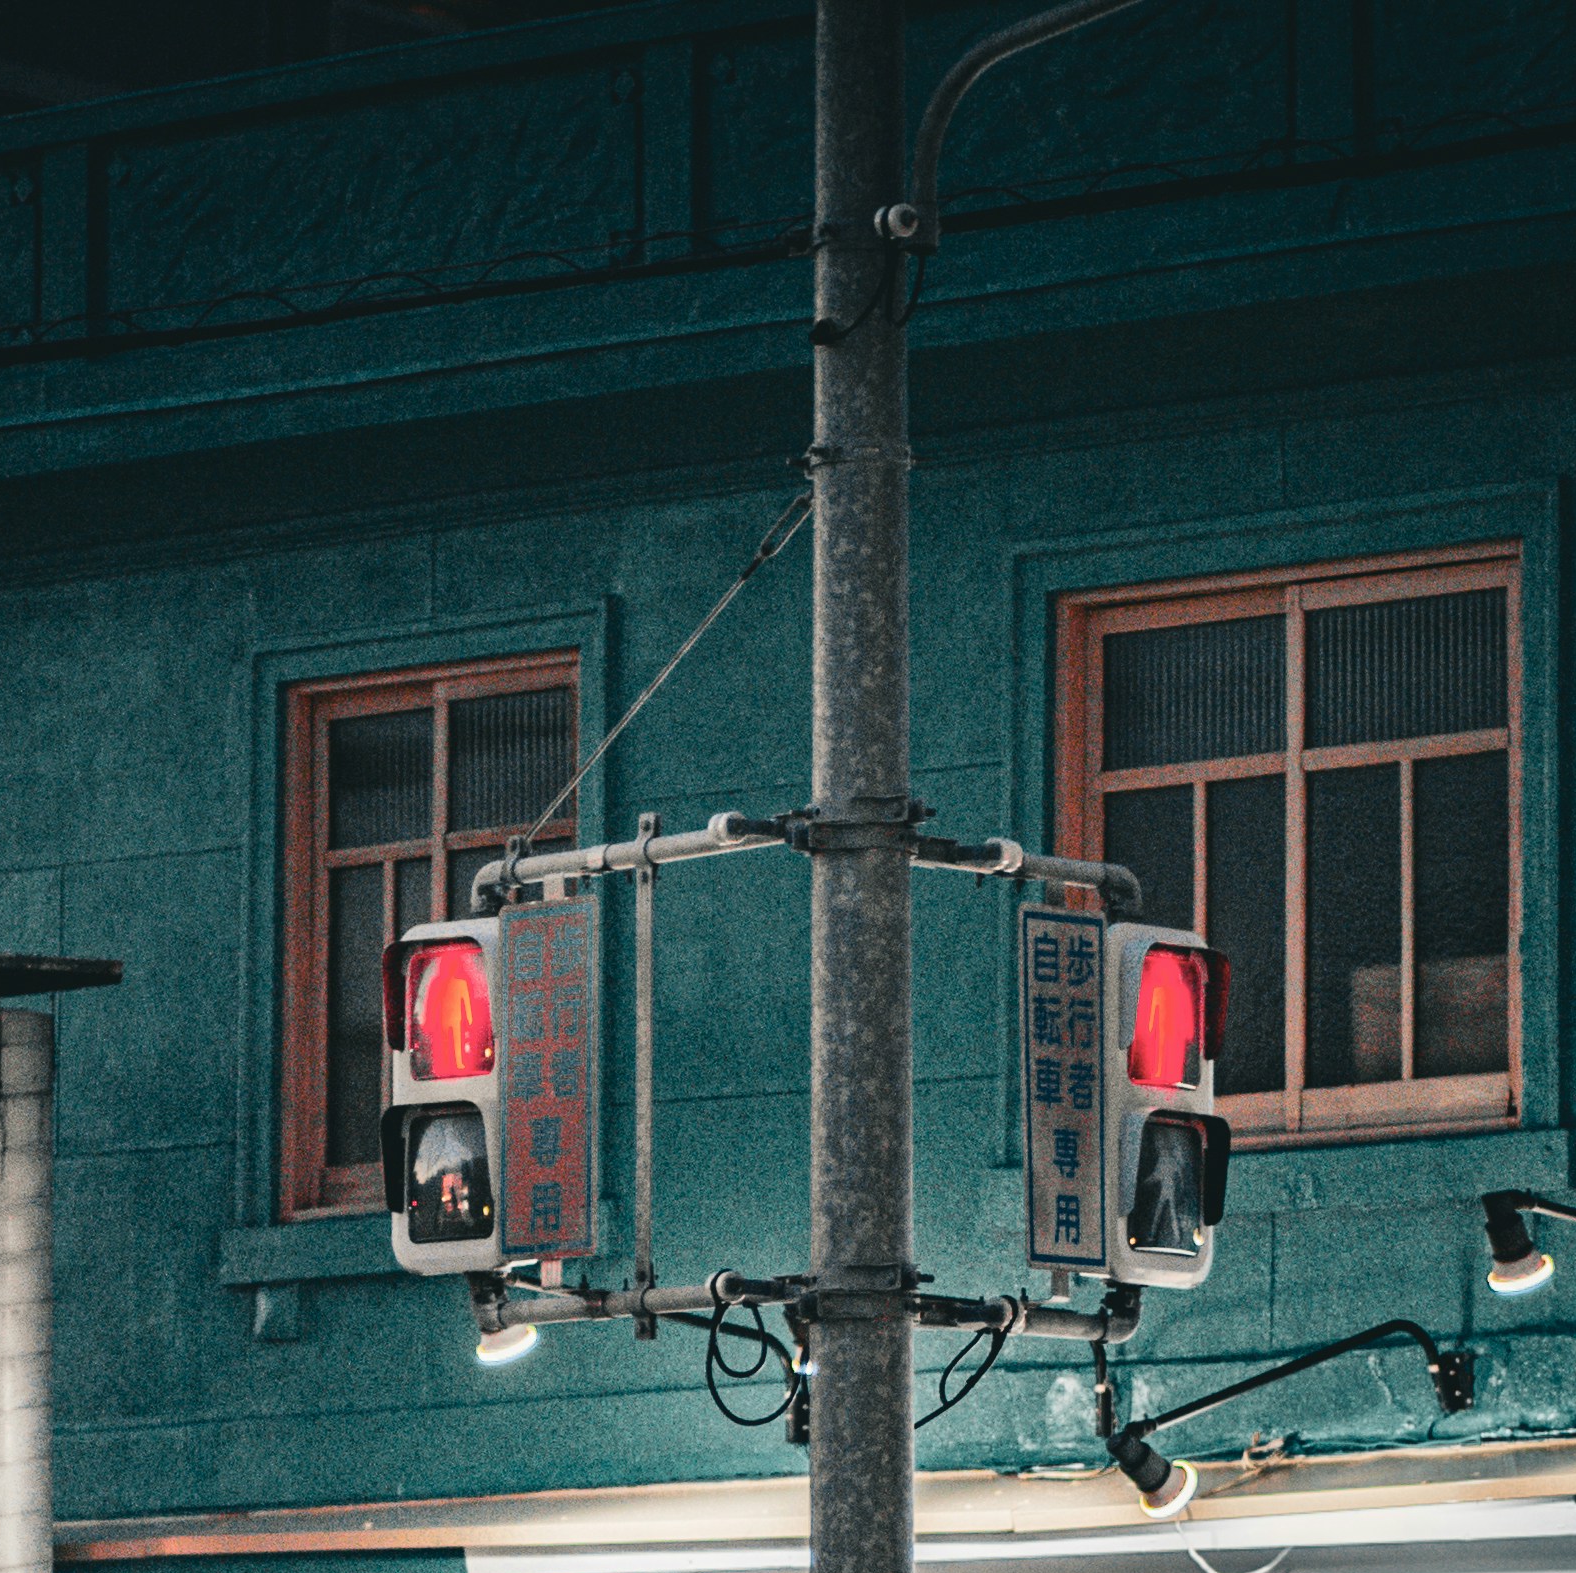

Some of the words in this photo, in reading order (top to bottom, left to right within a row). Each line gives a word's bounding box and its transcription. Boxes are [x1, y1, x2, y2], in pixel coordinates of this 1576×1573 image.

[1033, 930, 1062, 1107] 自転車
[1066, 934, 1096, 1110] 歩行者
[1053, 1126, 1081, 1245] 専用
